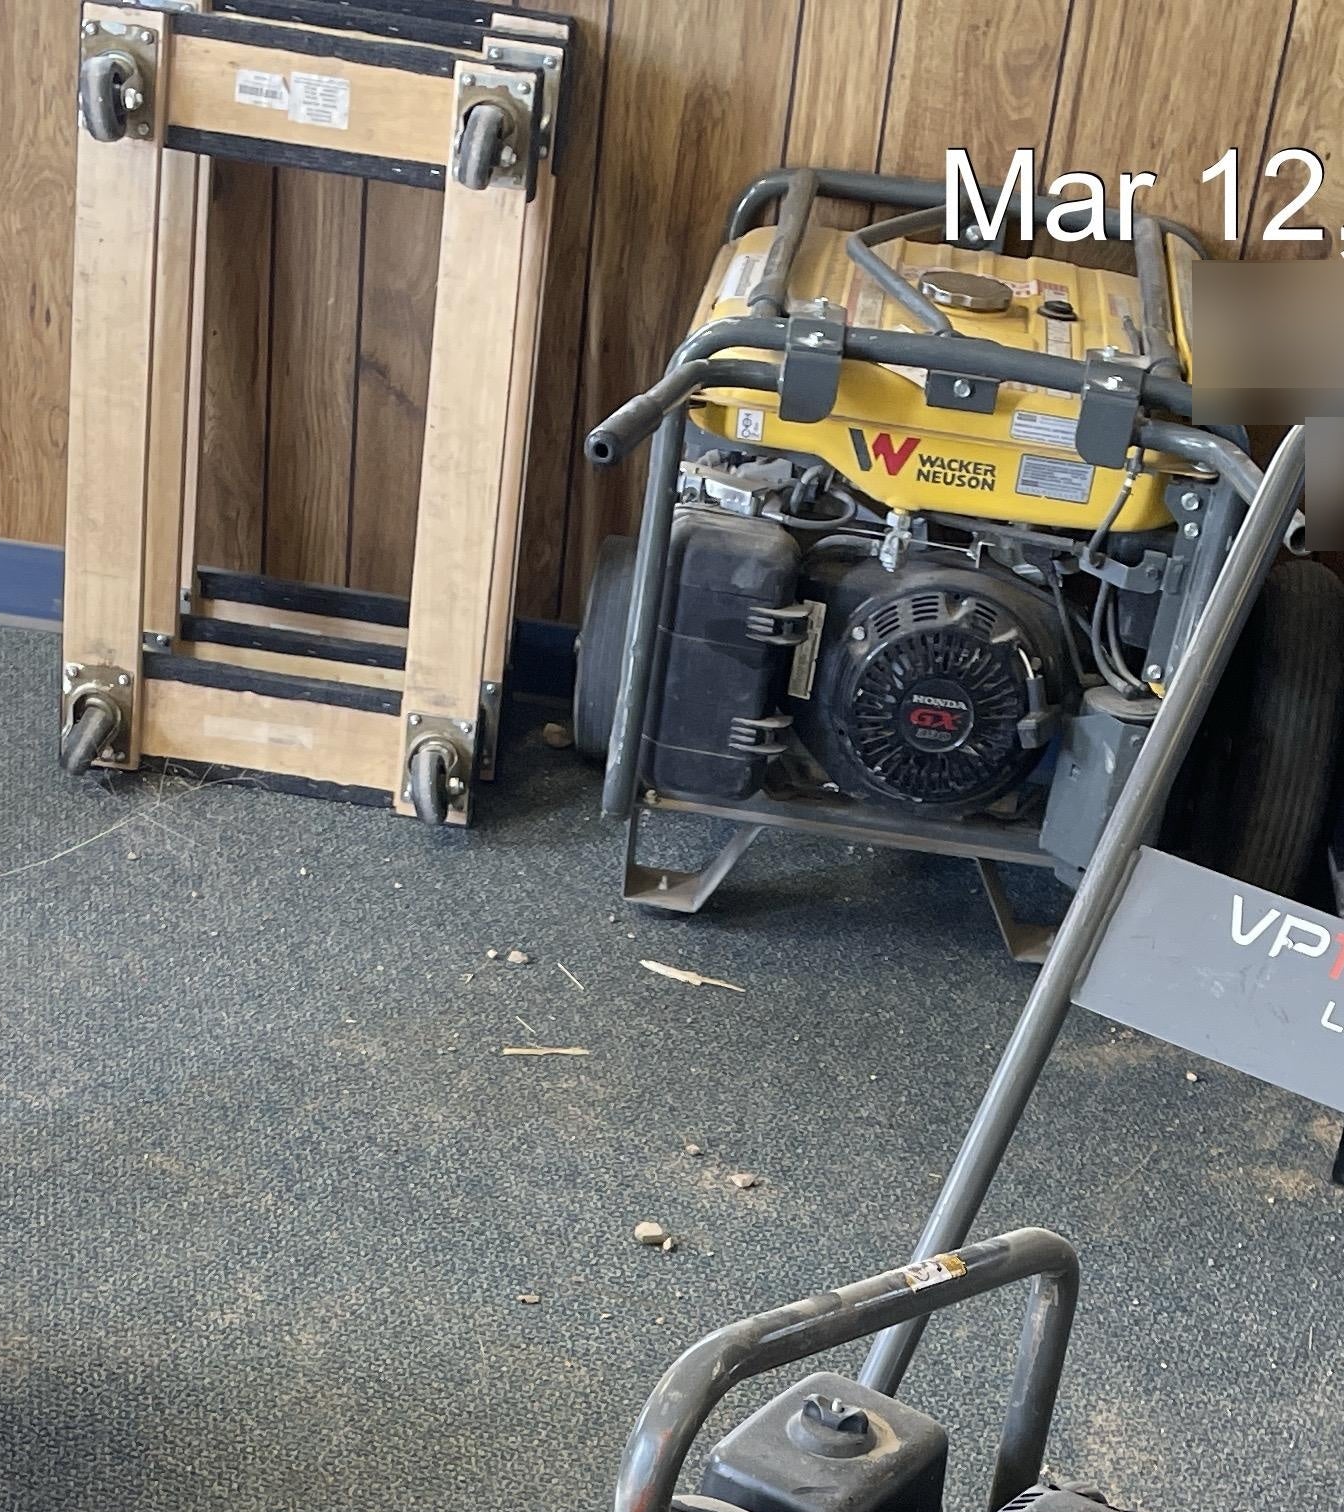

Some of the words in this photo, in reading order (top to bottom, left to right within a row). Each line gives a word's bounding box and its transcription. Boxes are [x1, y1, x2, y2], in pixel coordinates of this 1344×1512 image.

[917, 453, 997, 478] WACKER
[916, 468, 996, 491] NEUSON
[912, 694, 968, 711] HONDA
